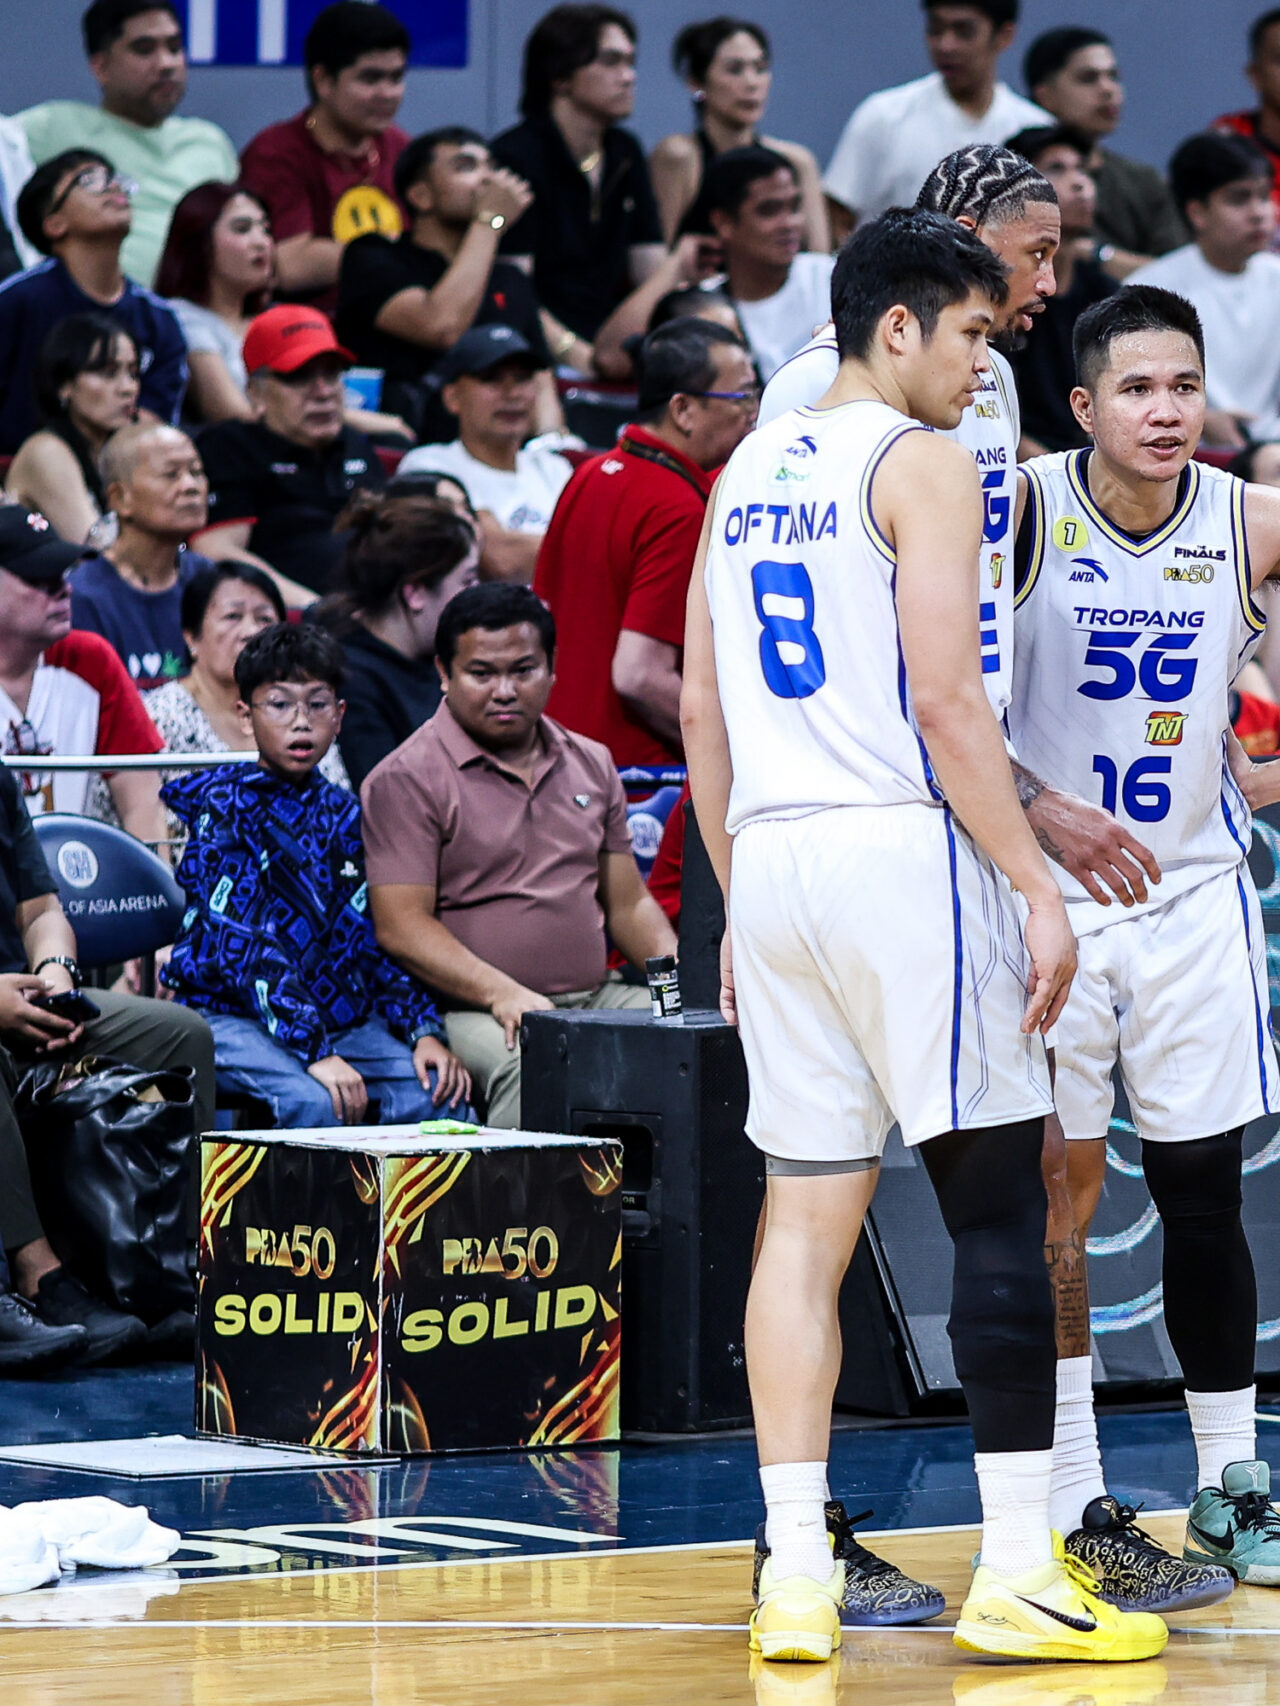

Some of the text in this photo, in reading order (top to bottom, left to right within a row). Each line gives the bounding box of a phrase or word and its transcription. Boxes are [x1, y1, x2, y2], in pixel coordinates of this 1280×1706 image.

[725, 501, 837, 546] OFTANA
[1064, 522, 1077, 546] 1
[1163, 564, 1215, 584] PBA50
[1174, 547, 1226, 561] FINALS
[1068, 571, 1095, 583] ANTA
[751, 560, 826, 699] 8
[1073, 607, 1205, 628] TROPANG
[1071, 628, 1199, 702] 5G
[1144, 714, 1189, 743] TNT
[1092, 755, 1172, 823] 16
[69, 900, 84, 915] OF
[89, 898, 117, 915] ASIA
[120, 894, 168, 912] ARENA
[246, 1224, 336, 1280] PBA50
[443, 1225, 559, 1280] PBA50
[213, 1291, 365, 1336] SOLID
[401, 1284, 598, 1353] SOLID
